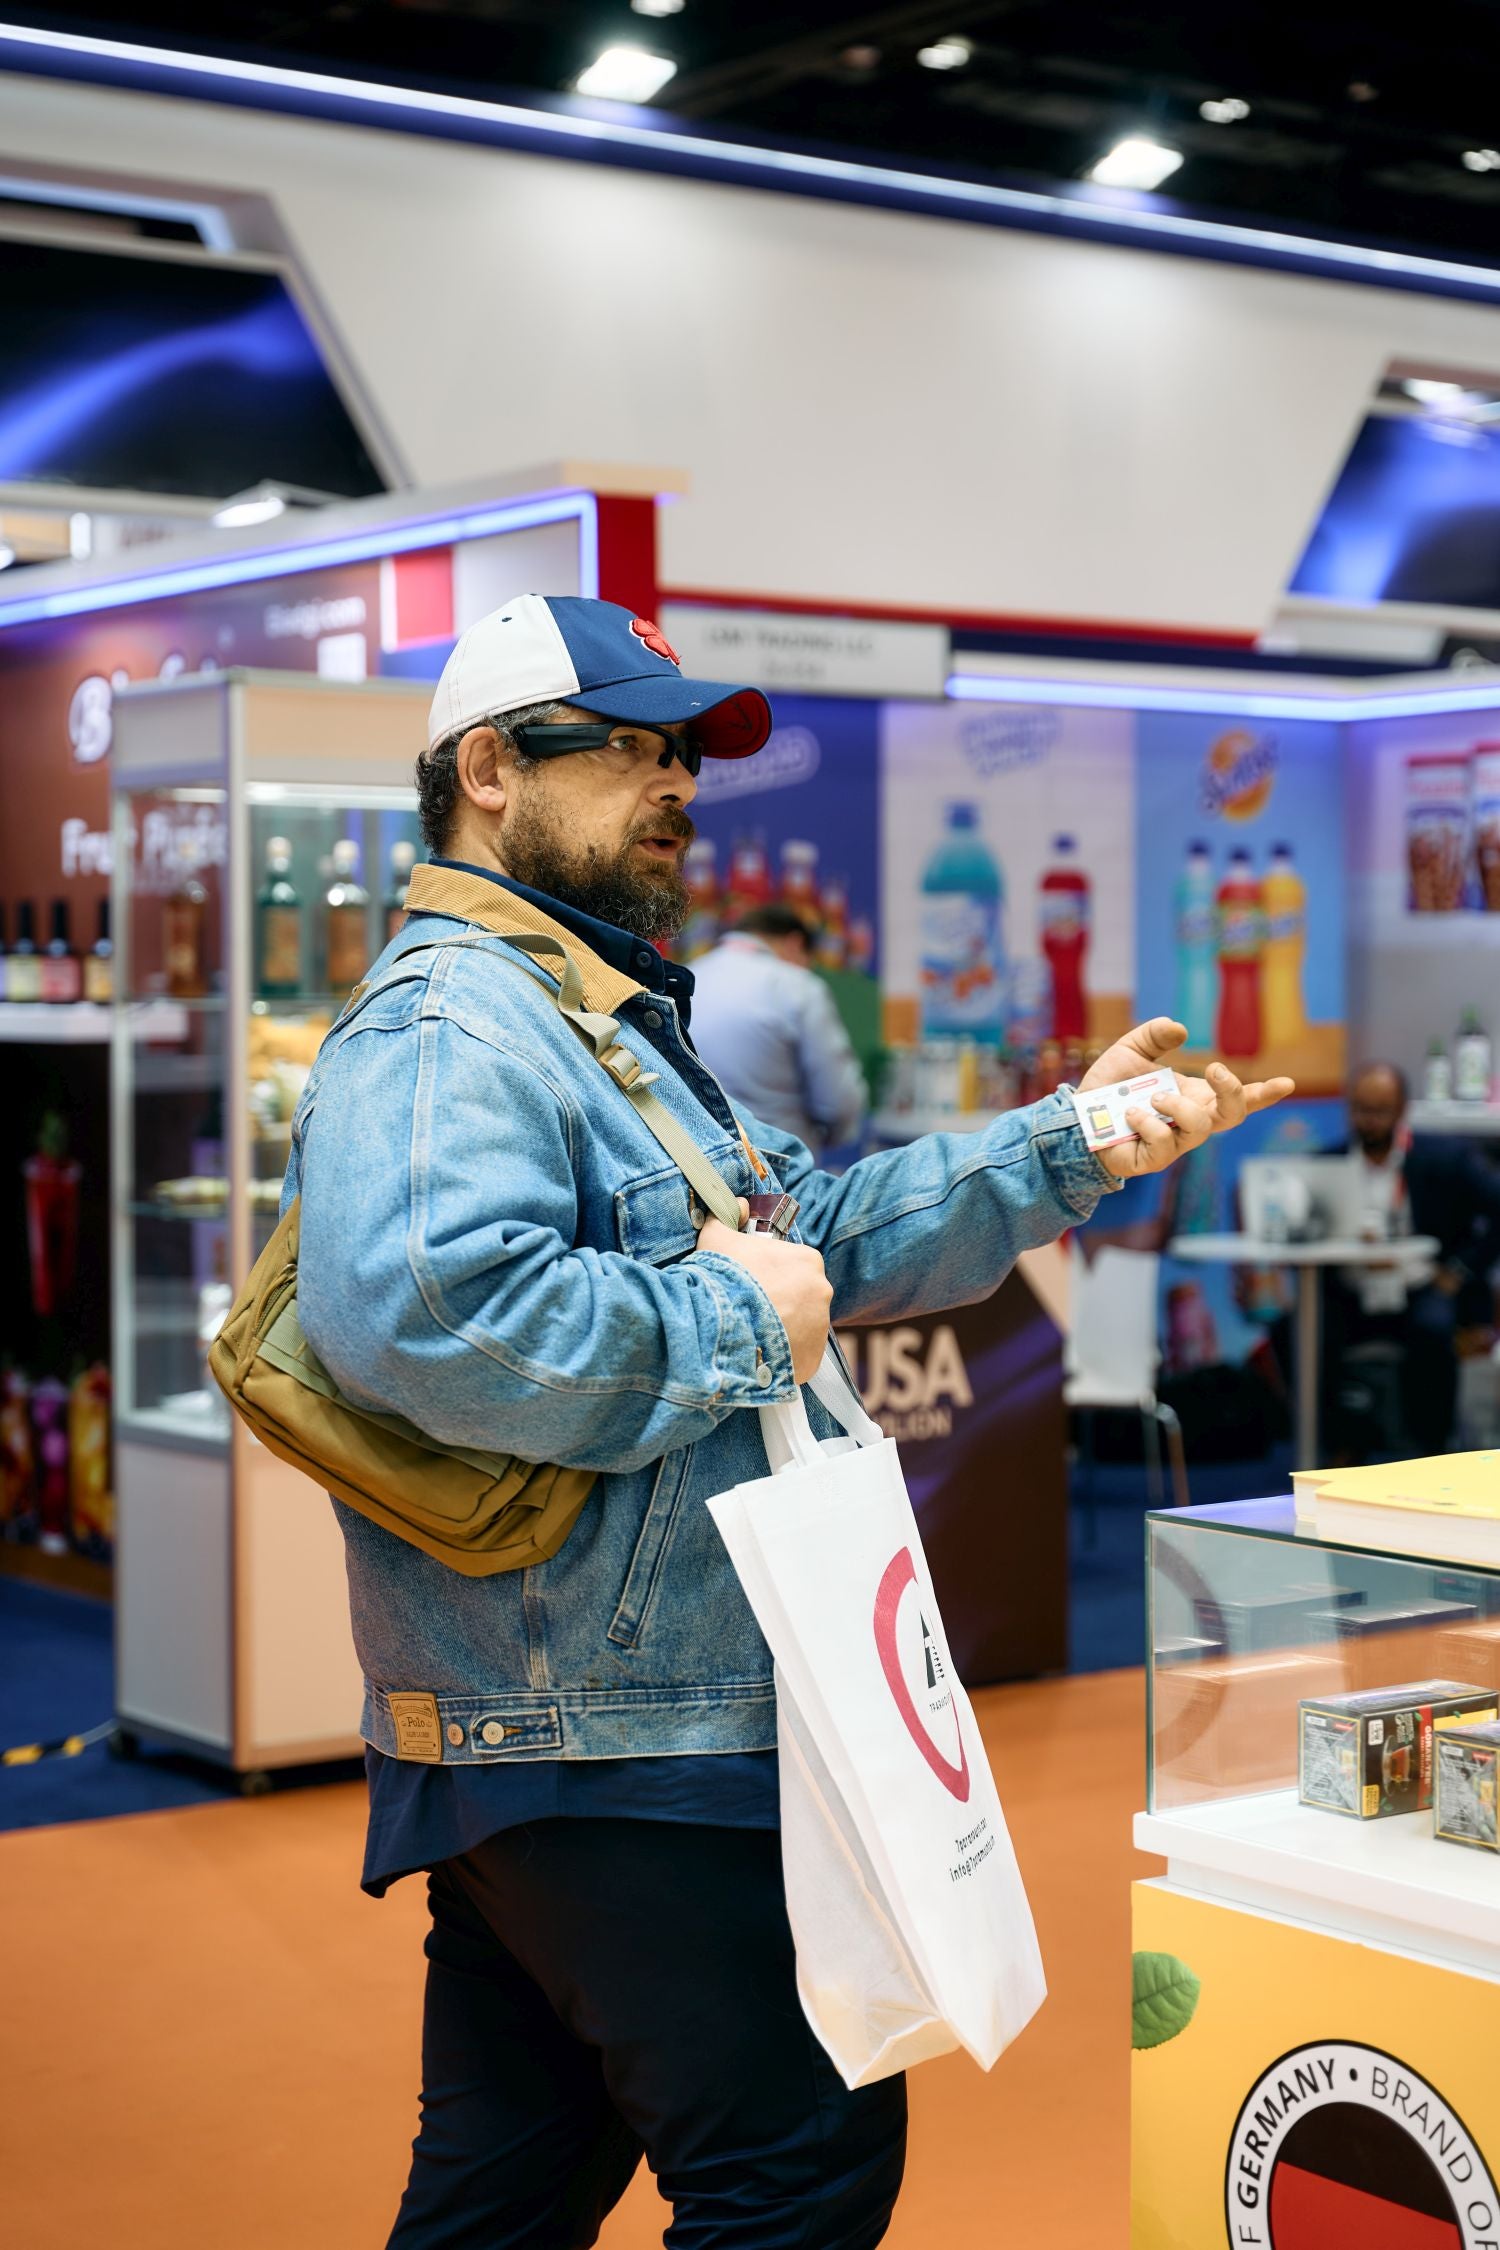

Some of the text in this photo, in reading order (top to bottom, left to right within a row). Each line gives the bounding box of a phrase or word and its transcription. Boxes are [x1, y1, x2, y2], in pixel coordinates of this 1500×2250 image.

[837, 1326, 974, 1413] USA
[406, 1716, 426, 1728] Polo
[1237, 2058, 1335, 2210] GERMANY
[1371, 2066, 1473, 2184] BRAND
